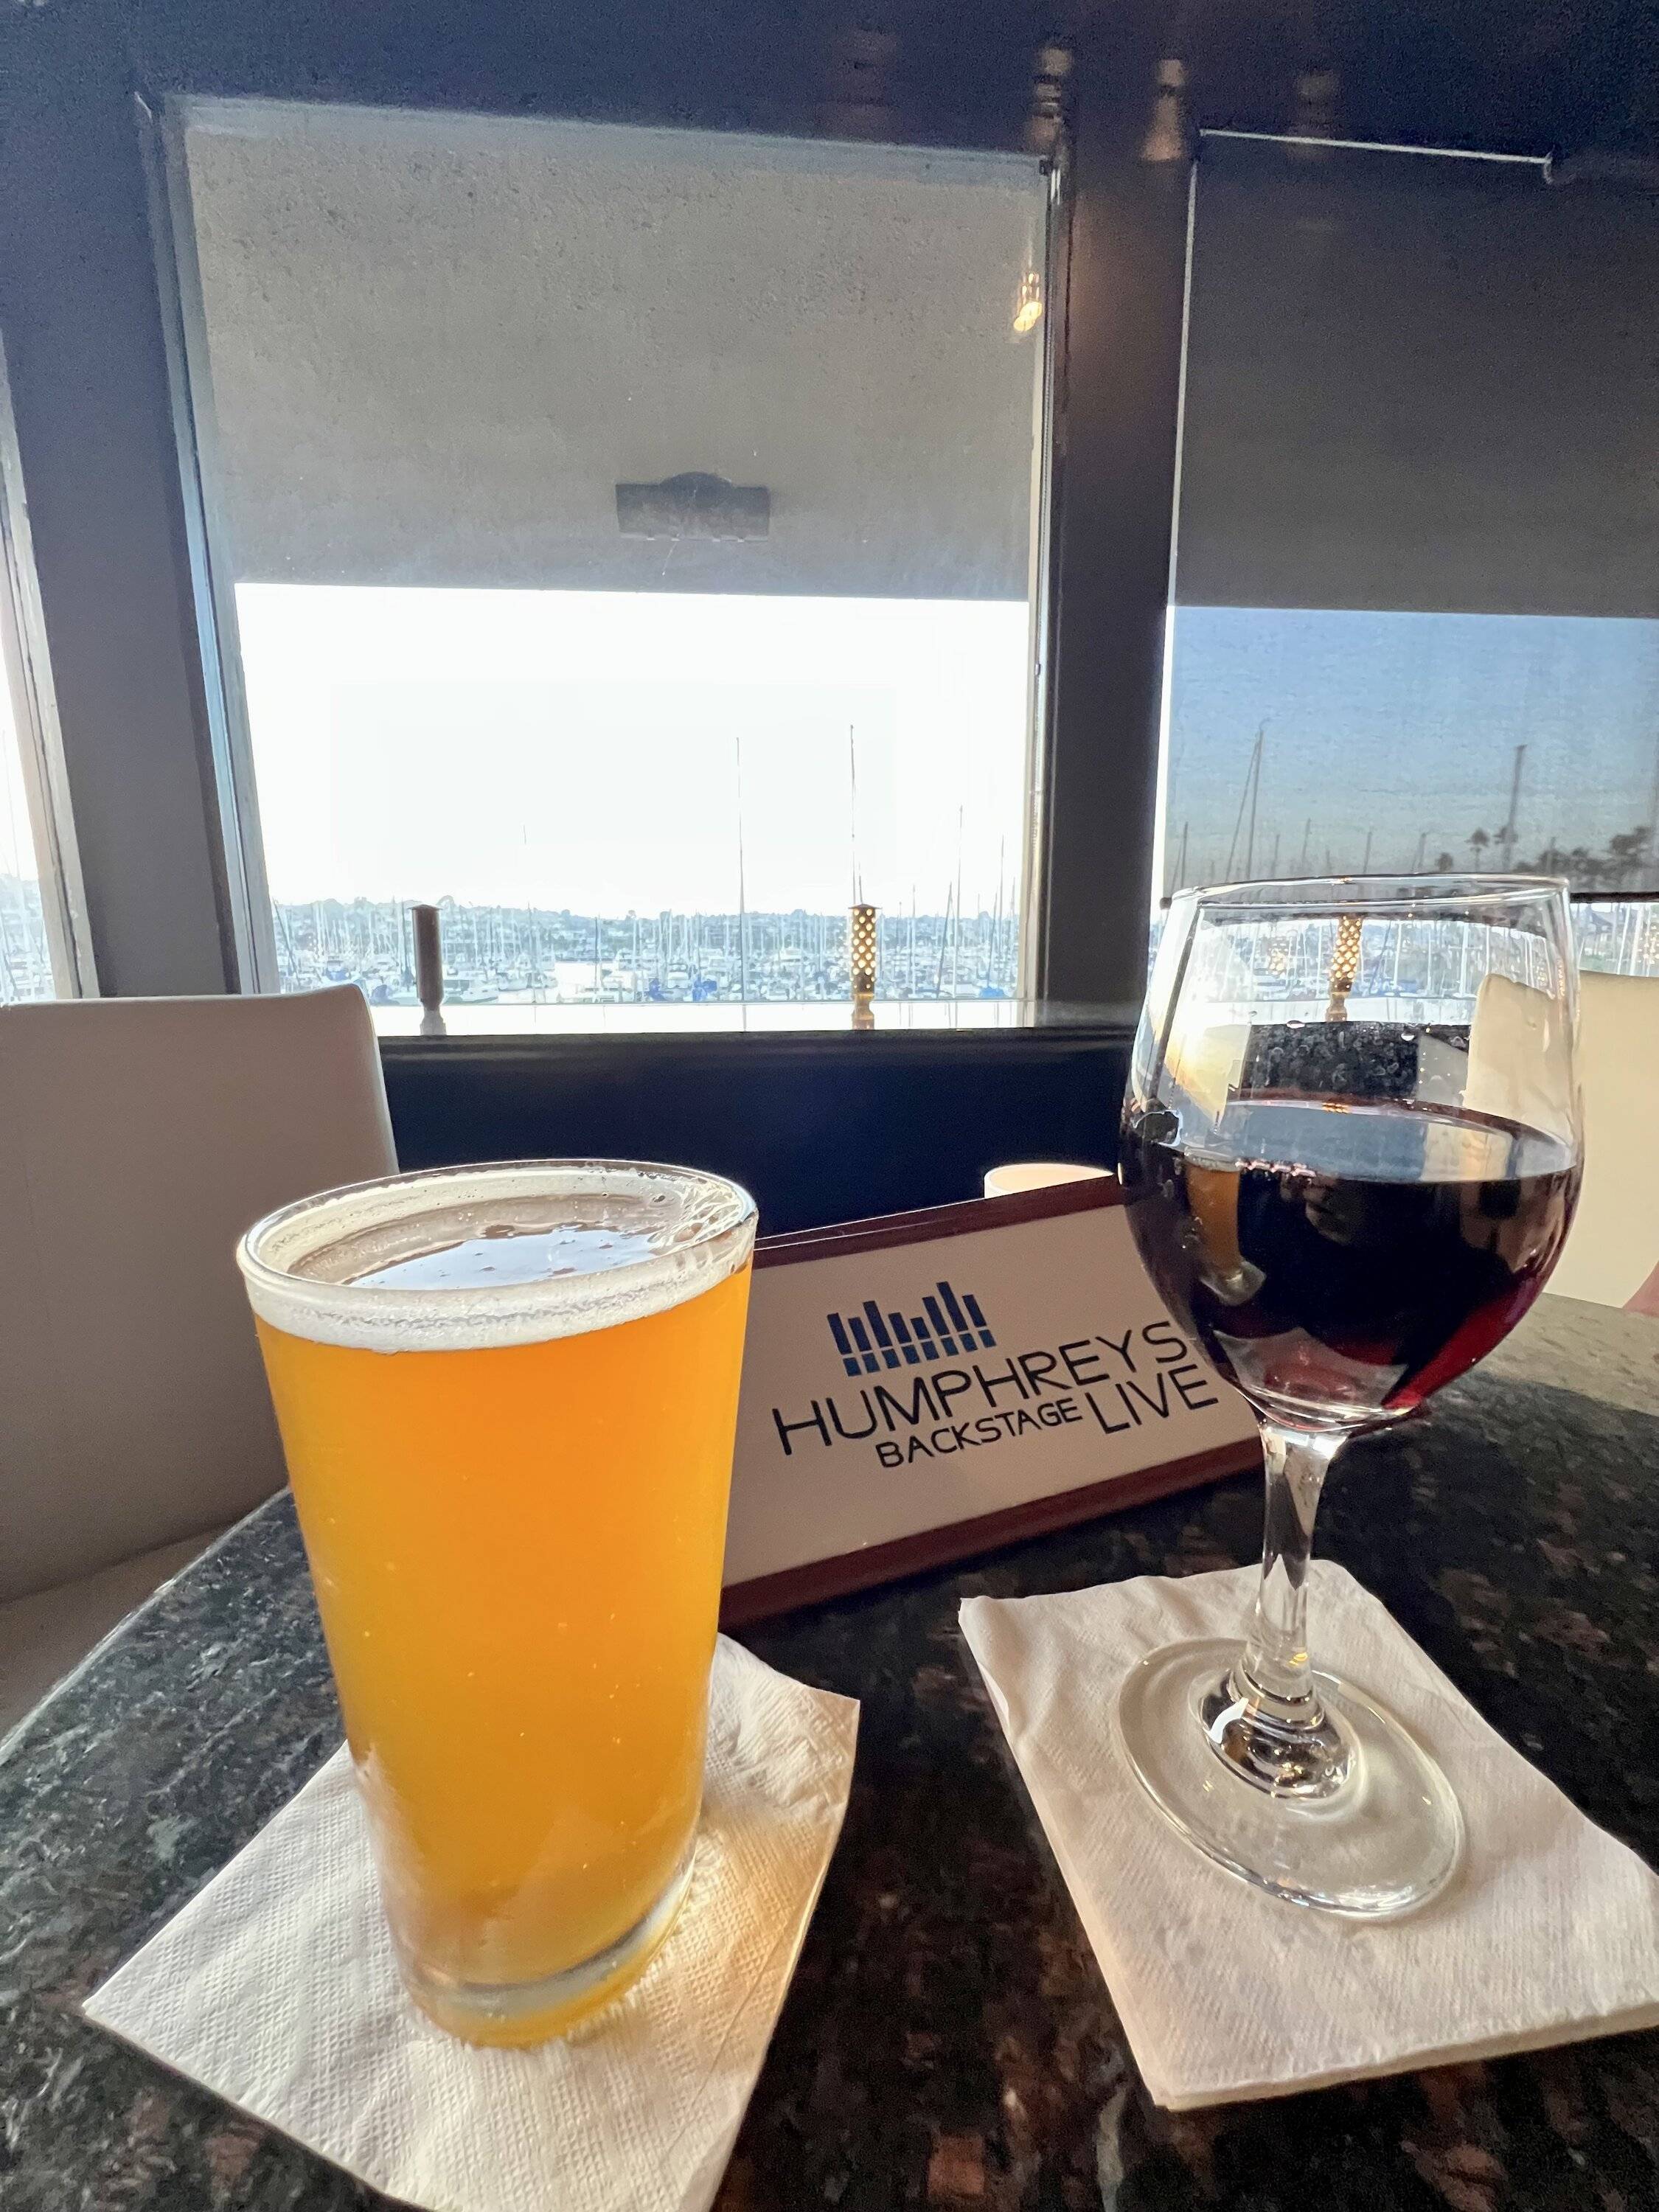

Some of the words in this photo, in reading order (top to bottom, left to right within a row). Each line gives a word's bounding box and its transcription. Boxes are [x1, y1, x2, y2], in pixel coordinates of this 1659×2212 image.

[772, 1321, 1189, 1455] HUMPHREYS
[876, 1398, 1083, 1468] BACKSTAGE
[1085, 1364, 1219, 1435] LIVE
